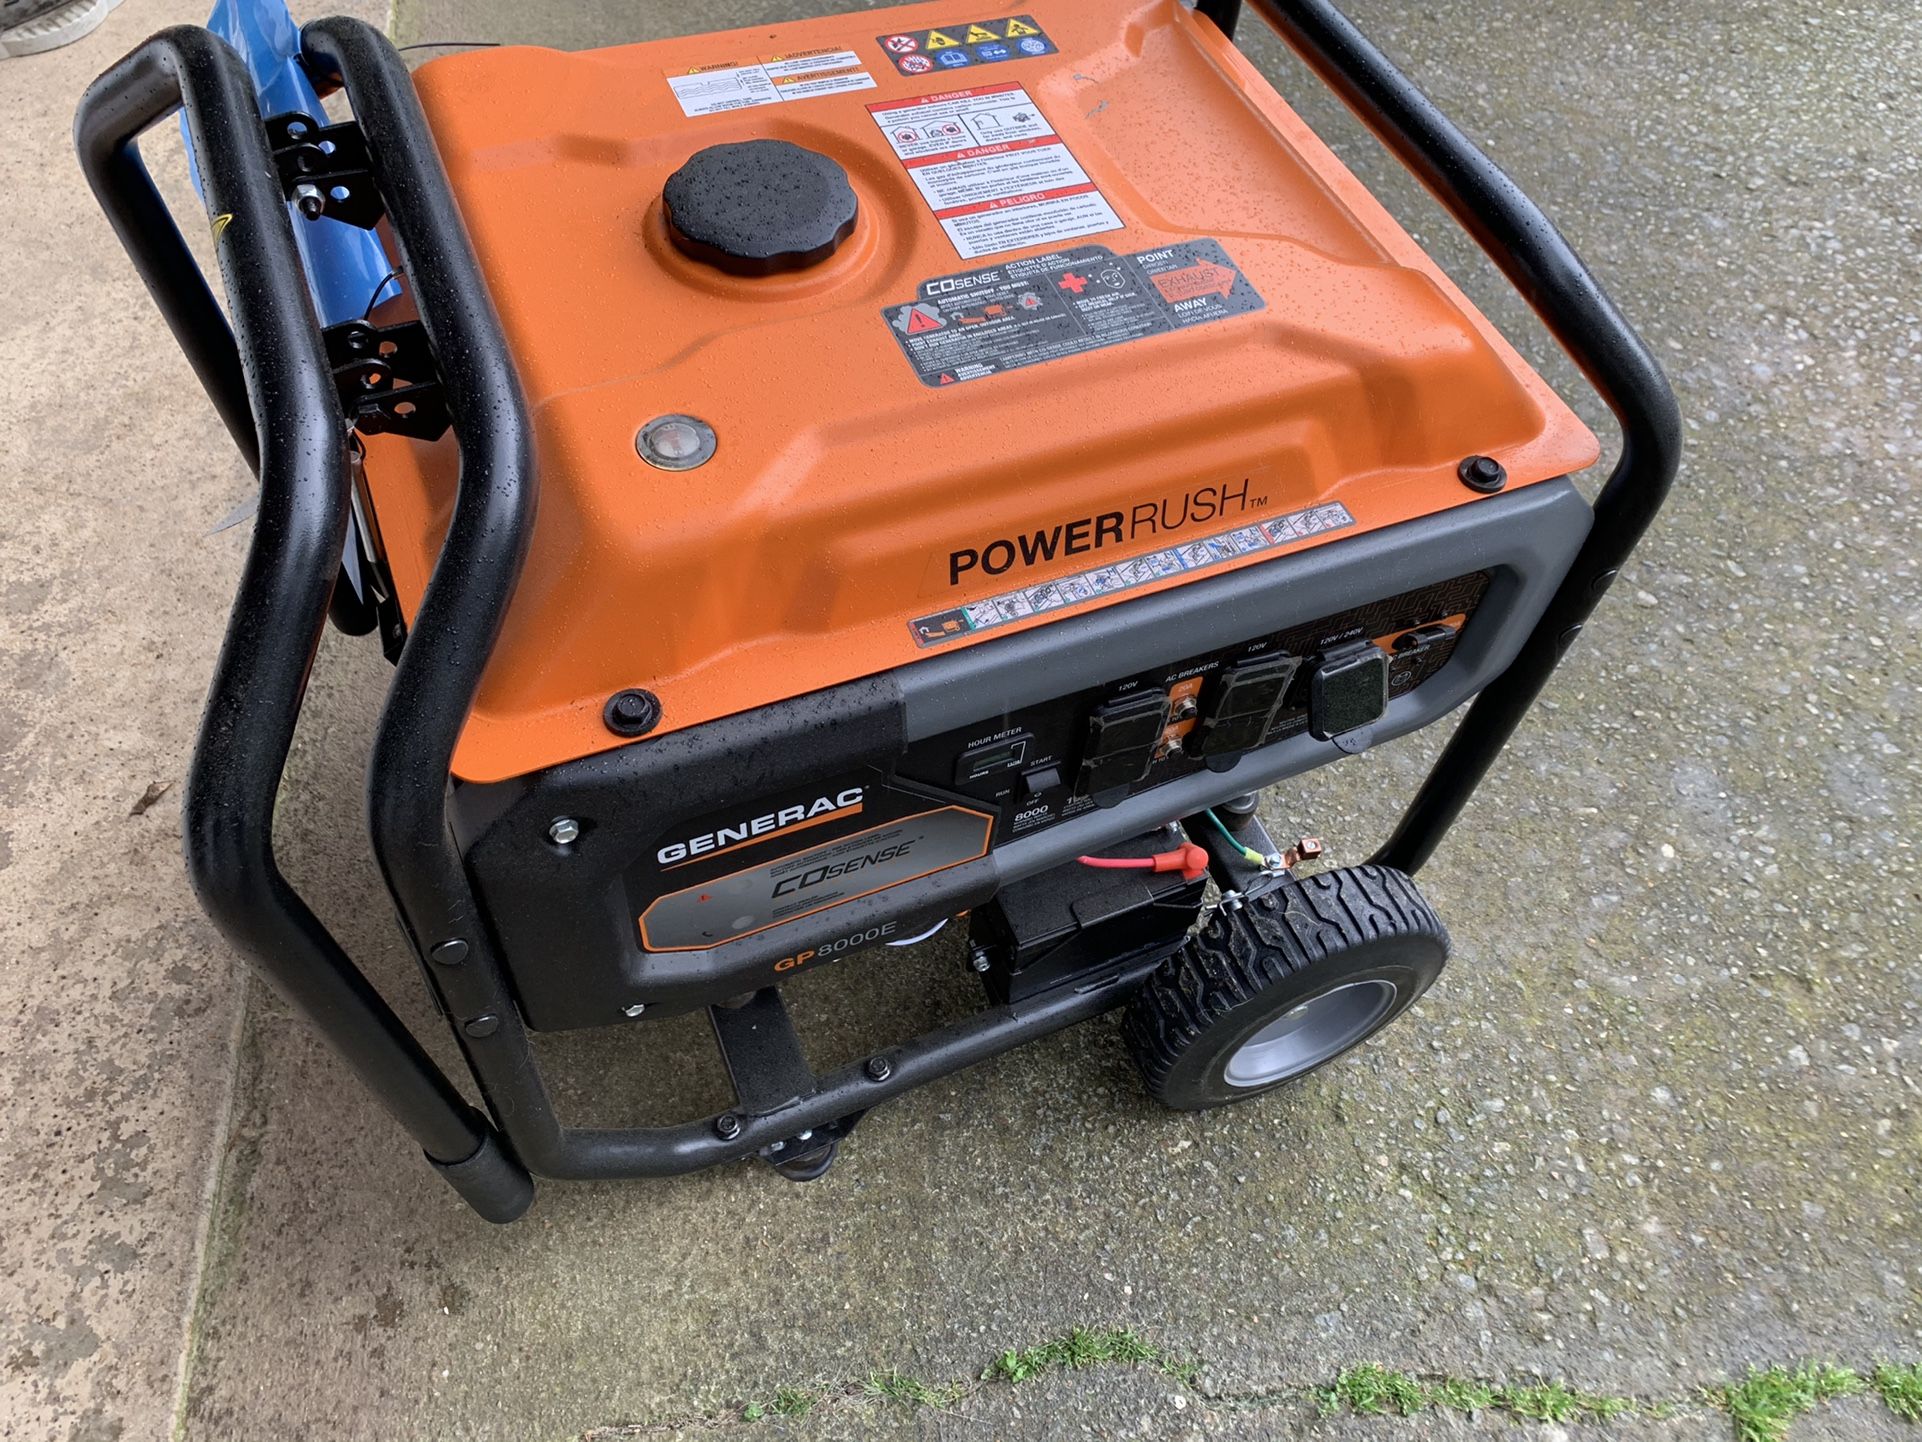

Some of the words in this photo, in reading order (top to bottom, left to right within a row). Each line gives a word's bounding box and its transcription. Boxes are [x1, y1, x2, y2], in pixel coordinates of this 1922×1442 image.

[701, 61, 739, 71] WARNING!
[931, 90, 972, 101] DANGER
[966, 144, 1010, 156] DANGER
[1000, 193, 1045, 206] PELIGRO
[1006, 260, 1035, 270] ACTION
[1036, 254, 1062, 264] LABEL
[1137, 250, 1175, 264] POINT
[926, 271, 1000, 296] COSENSE
[1159, 267, 1220, 287] EXHAUST
[1174, 297, 1207, 312] AWAY
[955, 364, 983, 372] WARNING
[949, 478, 1250, 586] POWERRUSH
[1248, 642, 1267, 652] 120V
[1165, 674, 1177, 682] AC
[1178, 661, 1219, 680] BREAKERS
[1119, 681, 1138, 691] 120V
[968, 736, 991, 748] HOUR
[994, 727, 1022, 740] METER
[1031, 756, 1052, 766] START
[1015, 805, 1048, 821] 8000
[657, 787, 863, 864] GENERAC
[772, 840, 915, 898] COSENSE
[774, 921, 898, 972] GP8000E
